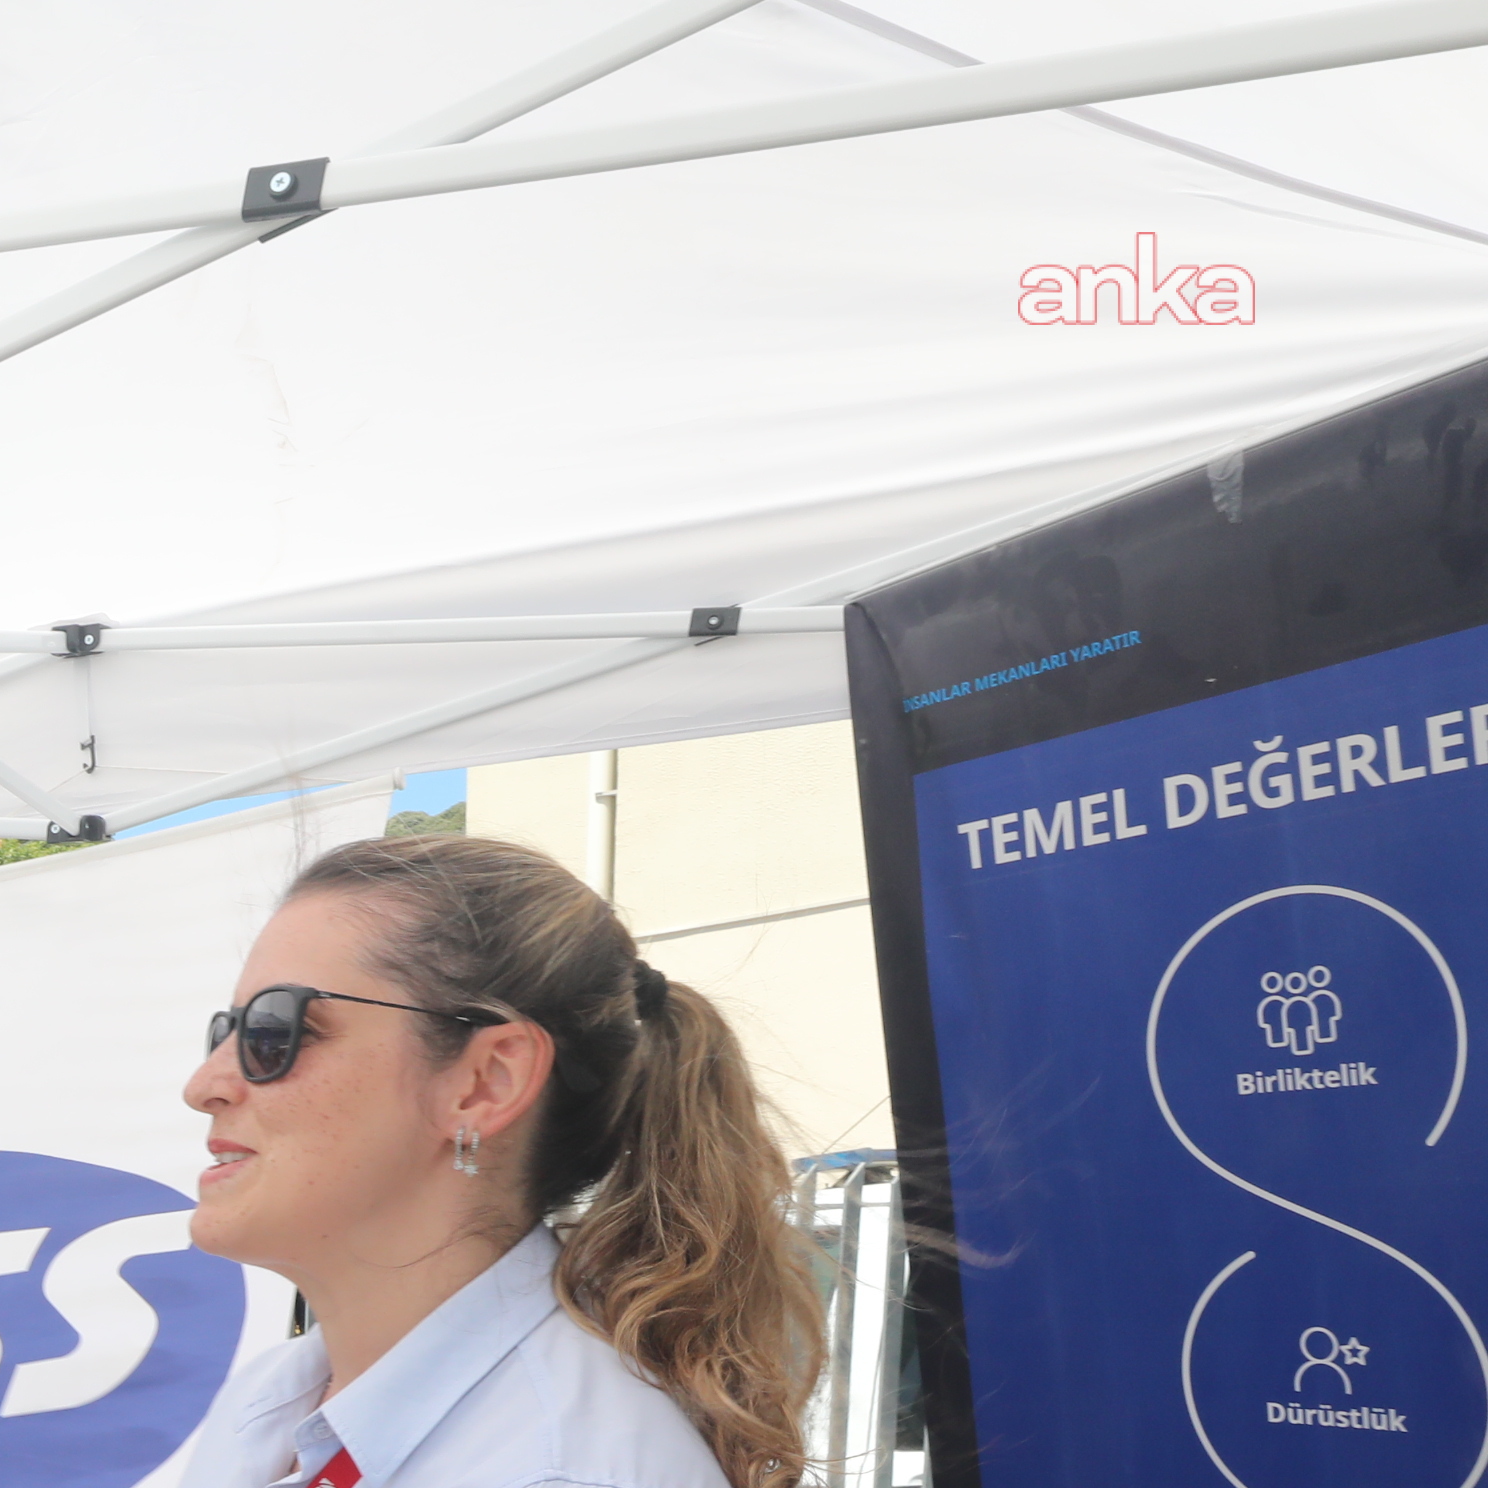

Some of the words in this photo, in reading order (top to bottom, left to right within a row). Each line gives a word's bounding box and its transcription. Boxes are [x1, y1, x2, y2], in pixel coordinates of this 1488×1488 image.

[974, 651, 1068, 692] MEKANLARI
[1069, 630, 1142, 663] YARATIR
[956, 788, 1148, 870] TEMEL
[1235, 1061, 1379, 1097] Birliktelik
[1266, 1401, 1409, 1434] Dürüstlük
